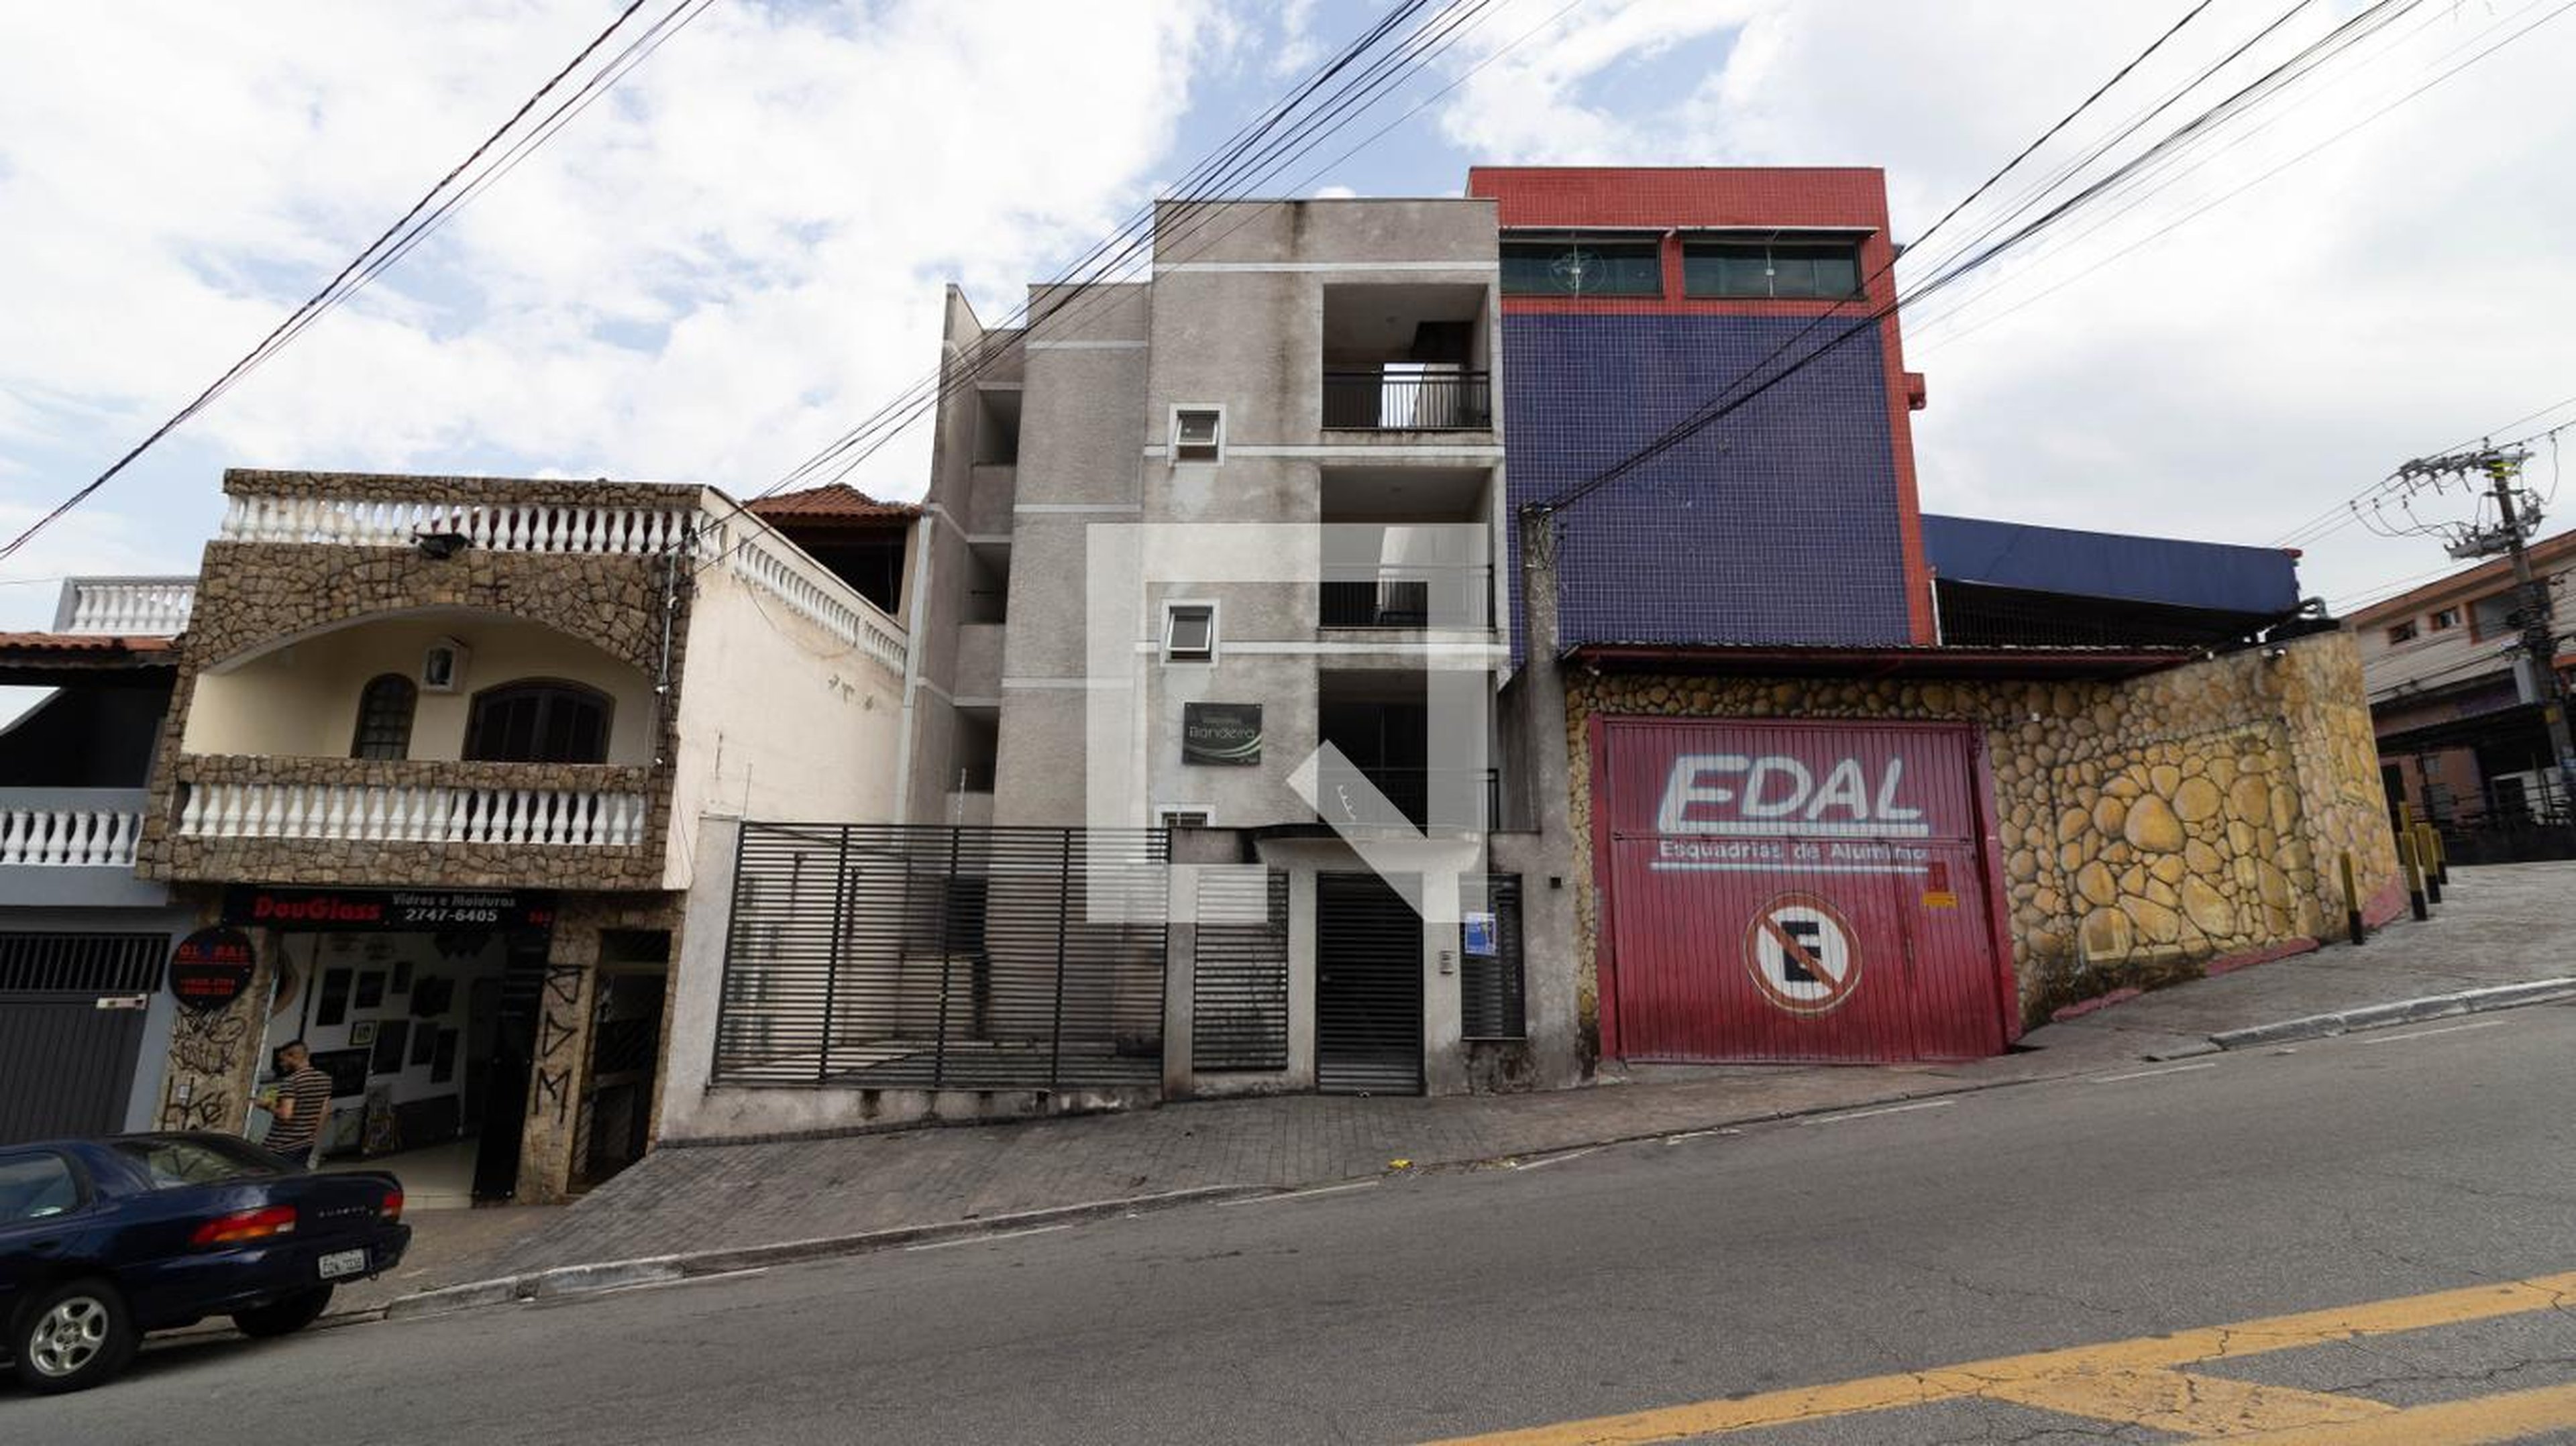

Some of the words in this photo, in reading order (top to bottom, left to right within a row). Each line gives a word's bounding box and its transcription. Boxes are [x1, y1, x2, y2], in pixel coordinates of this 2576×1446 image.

[1658, 754, 1929, 835] EDAL
[1660, 840, 1782, 860] Esquadrias
[1794, 843, 1819, 859] de
[392, 893, 436, 906] Vidros
[439, 897, 449, 907] e
[405, 908, 498, 922] 2747-6405
